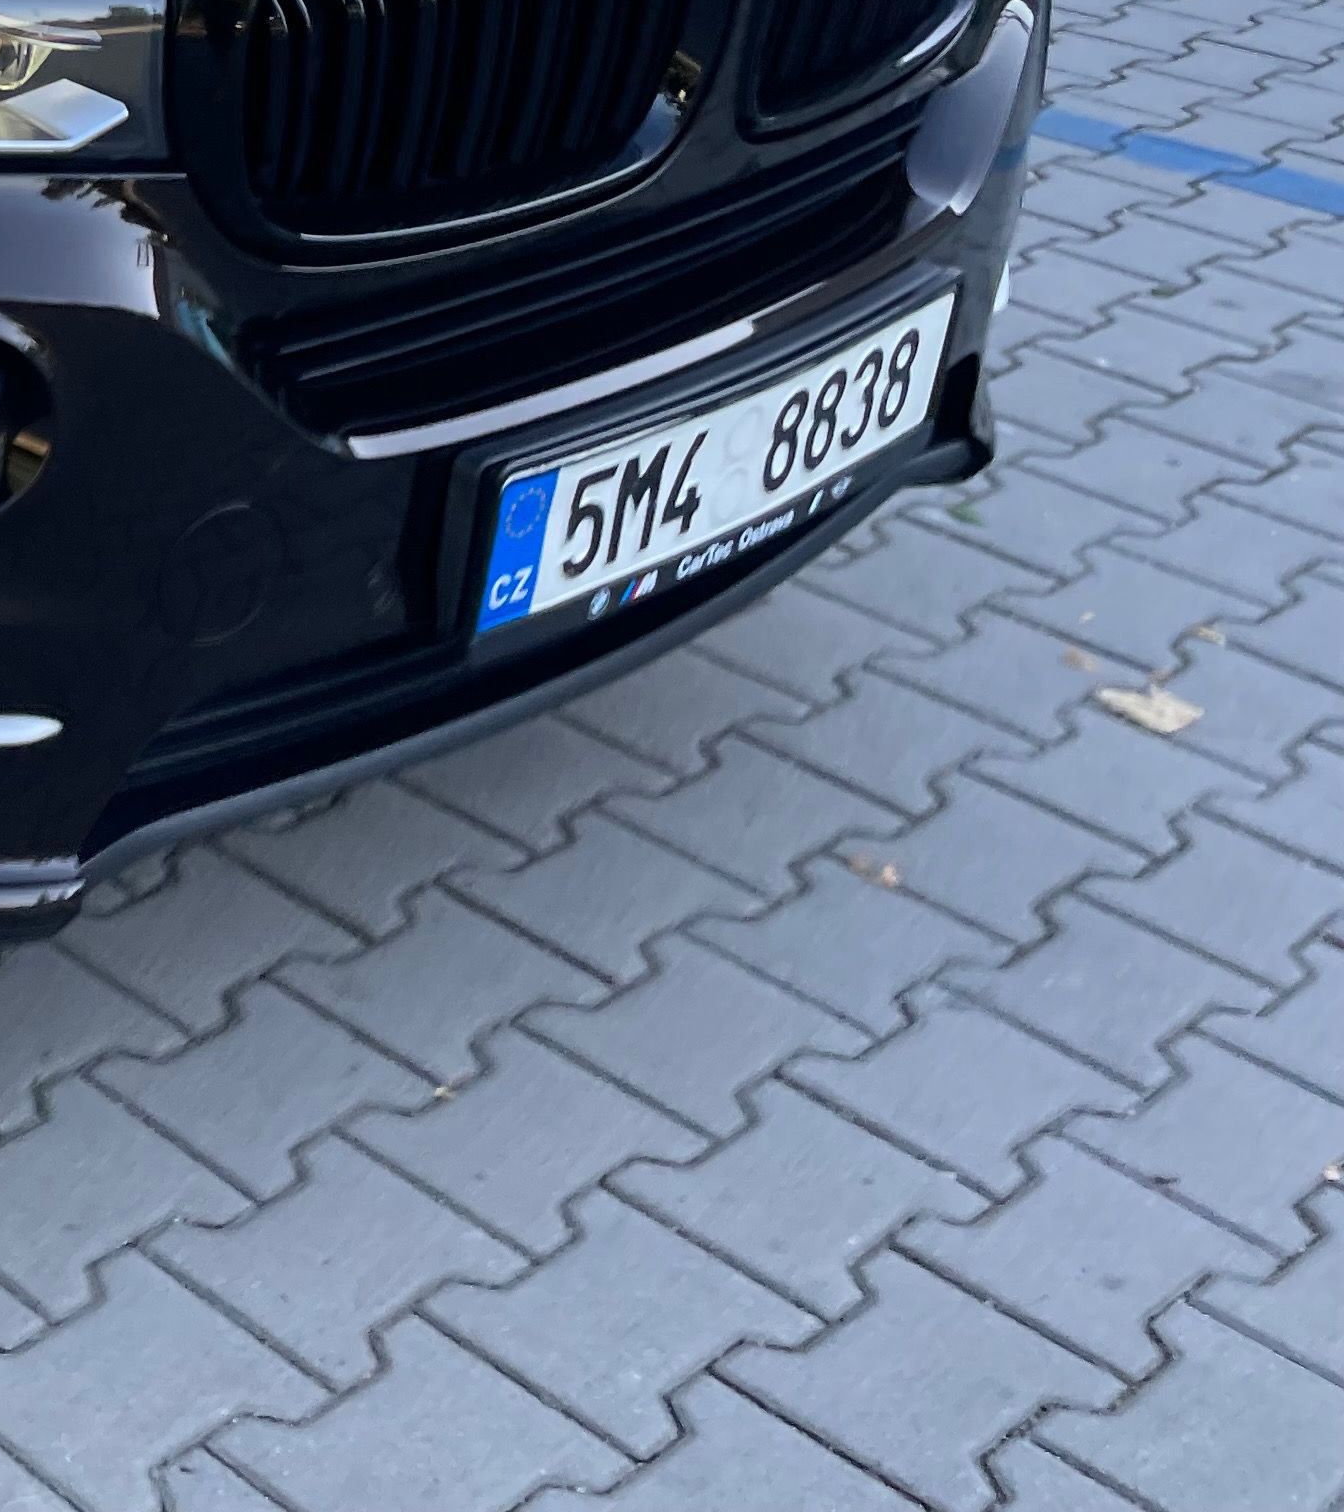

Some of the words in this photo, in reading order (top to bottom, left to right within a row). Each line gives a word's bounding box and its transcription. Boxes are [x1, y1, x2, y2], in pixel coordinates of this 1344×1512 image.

[562, 428, 709, 580] 5M4
[762, 328, 920, 493] 8838
[487, 563, 531, 611] CZ
